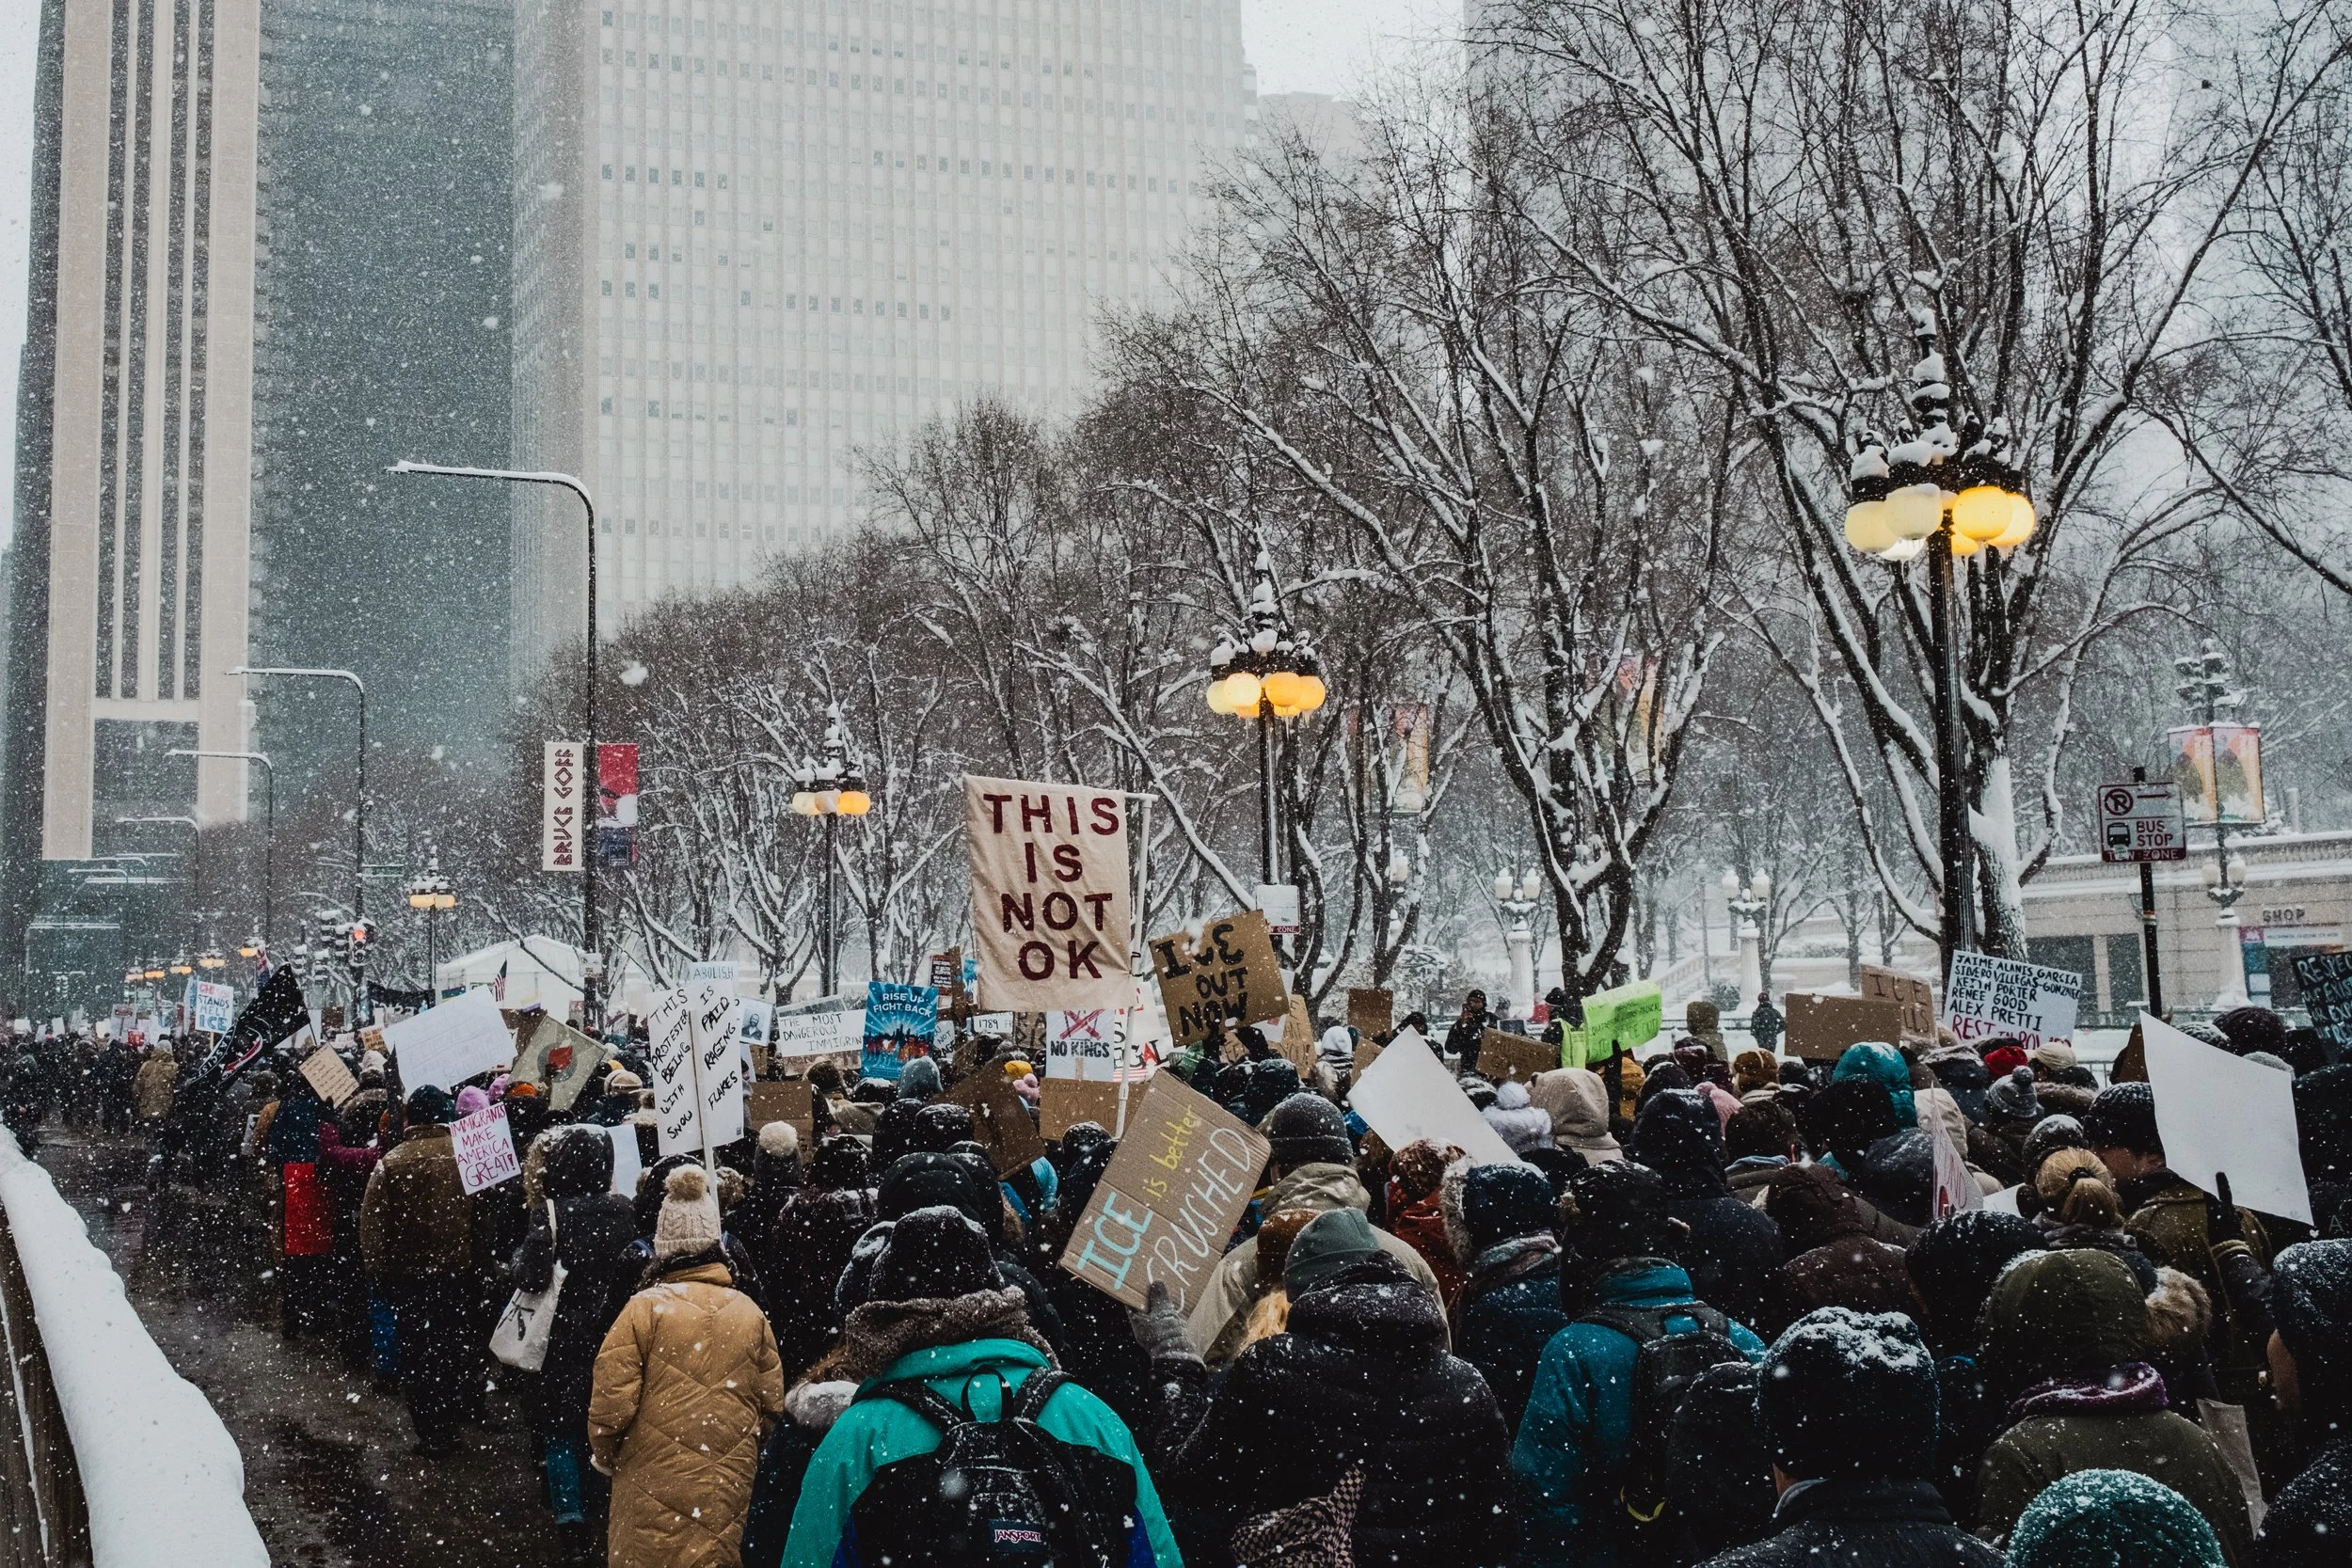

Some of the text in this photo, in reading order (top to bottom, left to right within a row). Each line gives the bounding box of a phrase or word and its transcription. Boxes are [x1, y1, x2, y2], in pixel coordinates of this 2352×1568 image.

[553, 749, 574, 865] BRUCE GOFF
[983, 793, 1120, 835] THIS
[2136, 820, 2165, 833] BUS
[2137, 833, 2174, 847] STOP
[1025, 842, 1083, 883] IS
[2107, 848, 2179, 862] TW ZONE
[1001, 892, 1113, 932] NOT
[2262, 907, 2306, 923] SHOP
[1017, 940, 1103, 980] OK
[1155, 924, 1244, 979] ICE
[693, 966, 734, 979] ABOLISH
[1195, 966, 1248, 999] OUT
[1957, 955, 2079, 987] JAIME ALANIS GARCIA
[198, 994, 230, 1008] STANDS
[700, 985, 714, 1006] IS
[882, 993, 925, 1003] RISE UP
[1869, 974, 1928, 1006] ICE
[1952, 987, 2027, 1011] RENEE GOOD
[1957, 976, 2038, 1002] KEITH PORTER
[650, 989, 688, 1023] THIS
[780, 1013, 843, 1027] THE MOST
[873, 1003, 932, 1018] FIGHT BACK
[1178, 992, 1248, 1037] NOW
[1949, 999, 2043, 1031] ALEX PRETTI
[199, 1014, 227, 1032] ICE
[783, 1025, 837, 1041] DANGEROUS
[978, 1018, 999, 1030] 1789
[1952, 1014, 1996, 1040] REST
[651, 1008, 689, 1072] PROTESTER
[704, 1022, 736, 1070] RAGING
[1050, 1039, 1110, 1058] NO KINGS
[660, 1041, 691, 1085] BEING
[660, 1084, 685, 1115] WITH
[707, 1070, 738, 1111] FLAKES
[452, 1104, 505, 1137] IMMIGRANTS
[667, 1110, 692, 1139] SNOW
[457, 1138, 510, 1166] AMERICA
[462, 1126, 496, 1149] MAKE
[1149, 1105, 1198, 1171] better
[466, 1152, 516, 1187] GREAT!
[1142, 1177, 1168, 1198] is
[1146, 1128, 1251, 1314] CRUSHED
[1076, 1191, 1154, 1291] ICE
